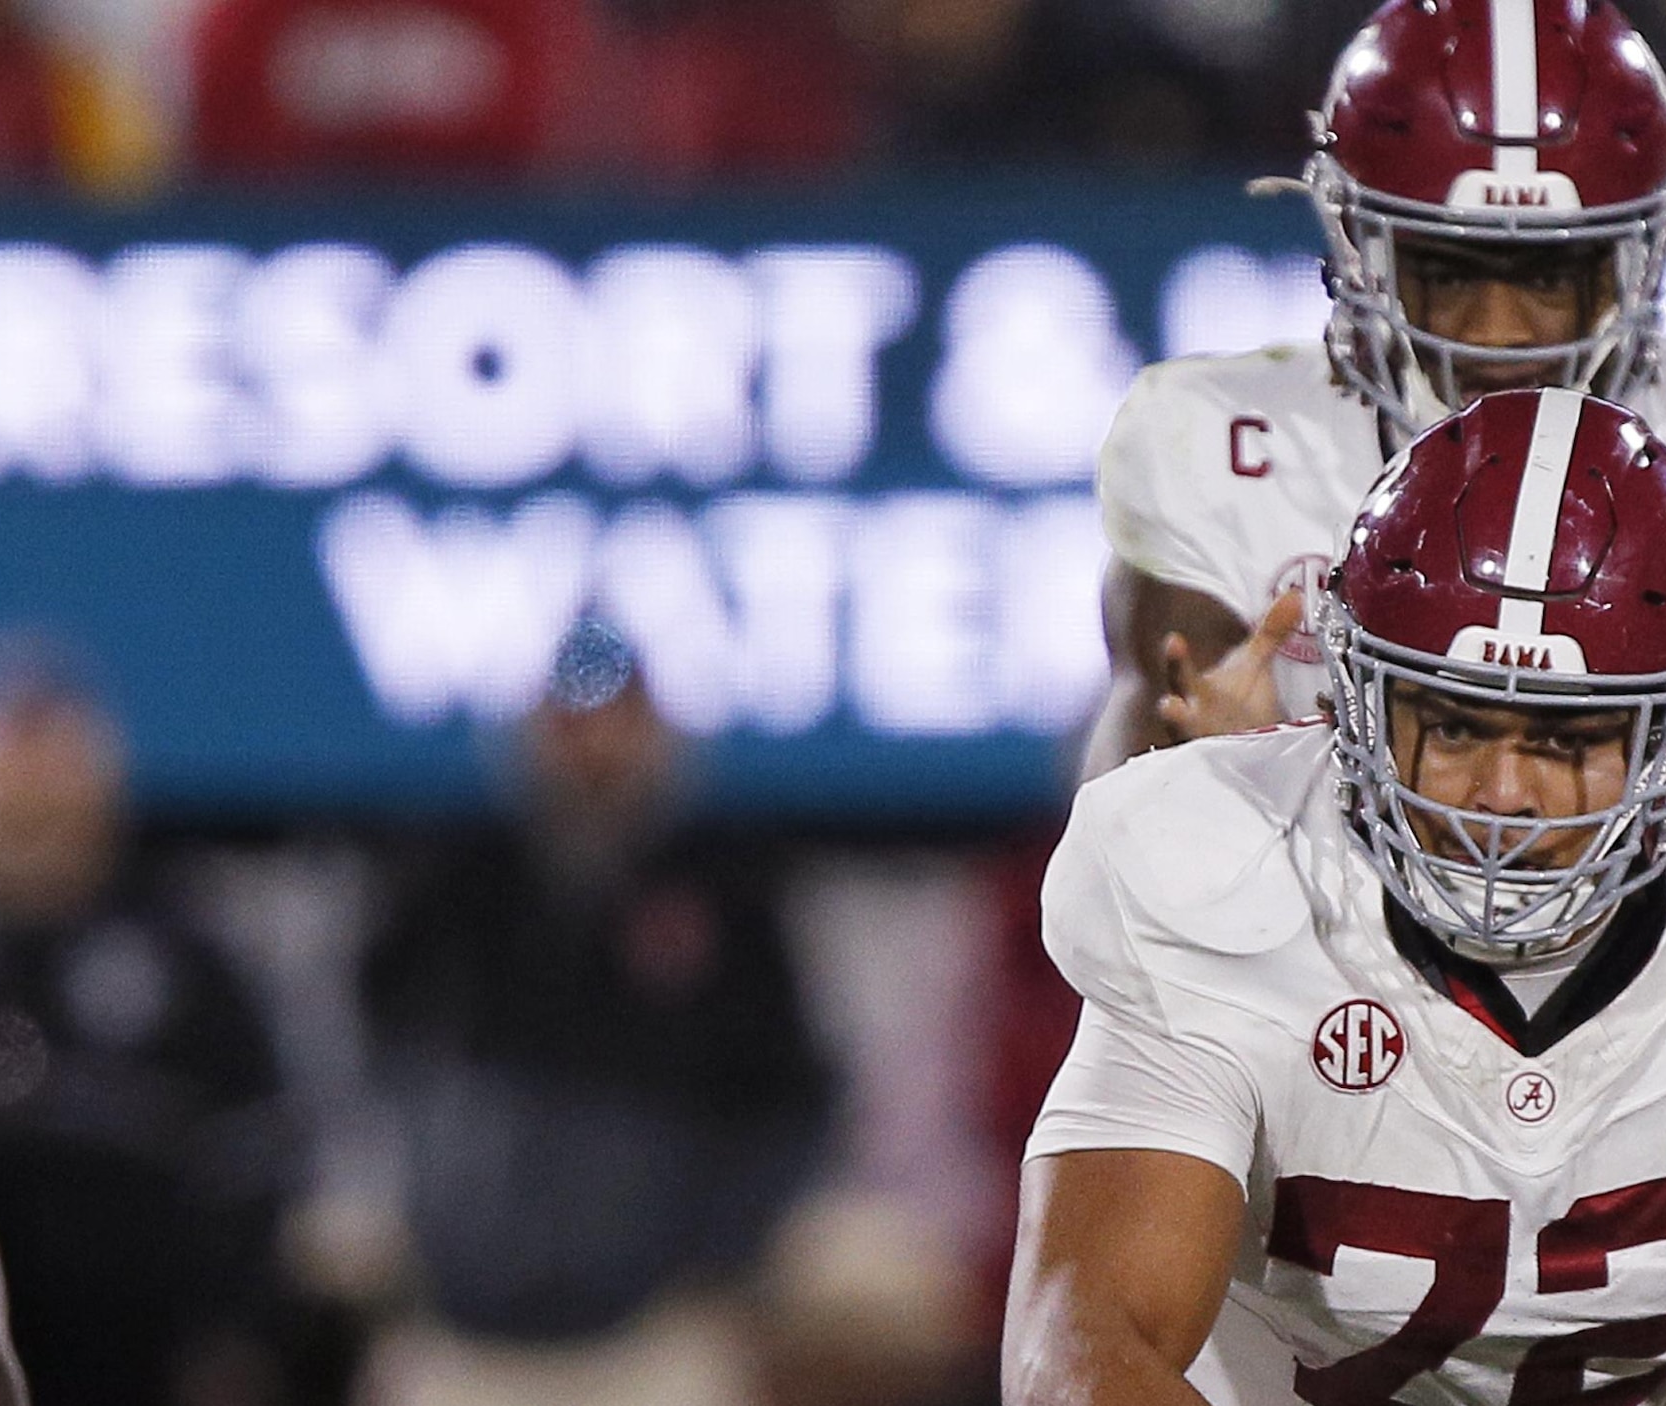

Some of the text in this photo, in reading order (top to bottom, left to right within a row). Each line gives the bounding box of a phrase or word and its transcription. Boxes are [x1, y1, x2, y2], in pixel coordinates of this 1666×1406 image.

[1483, 185, 1550, 207] BAMA
[1230, 416, 1271, 477] C
[1483, 640, 1553, 670] BAMA
[1317, 1002, 1400, 1087] SEC
[1513, 1079, 1544, 1111] A
